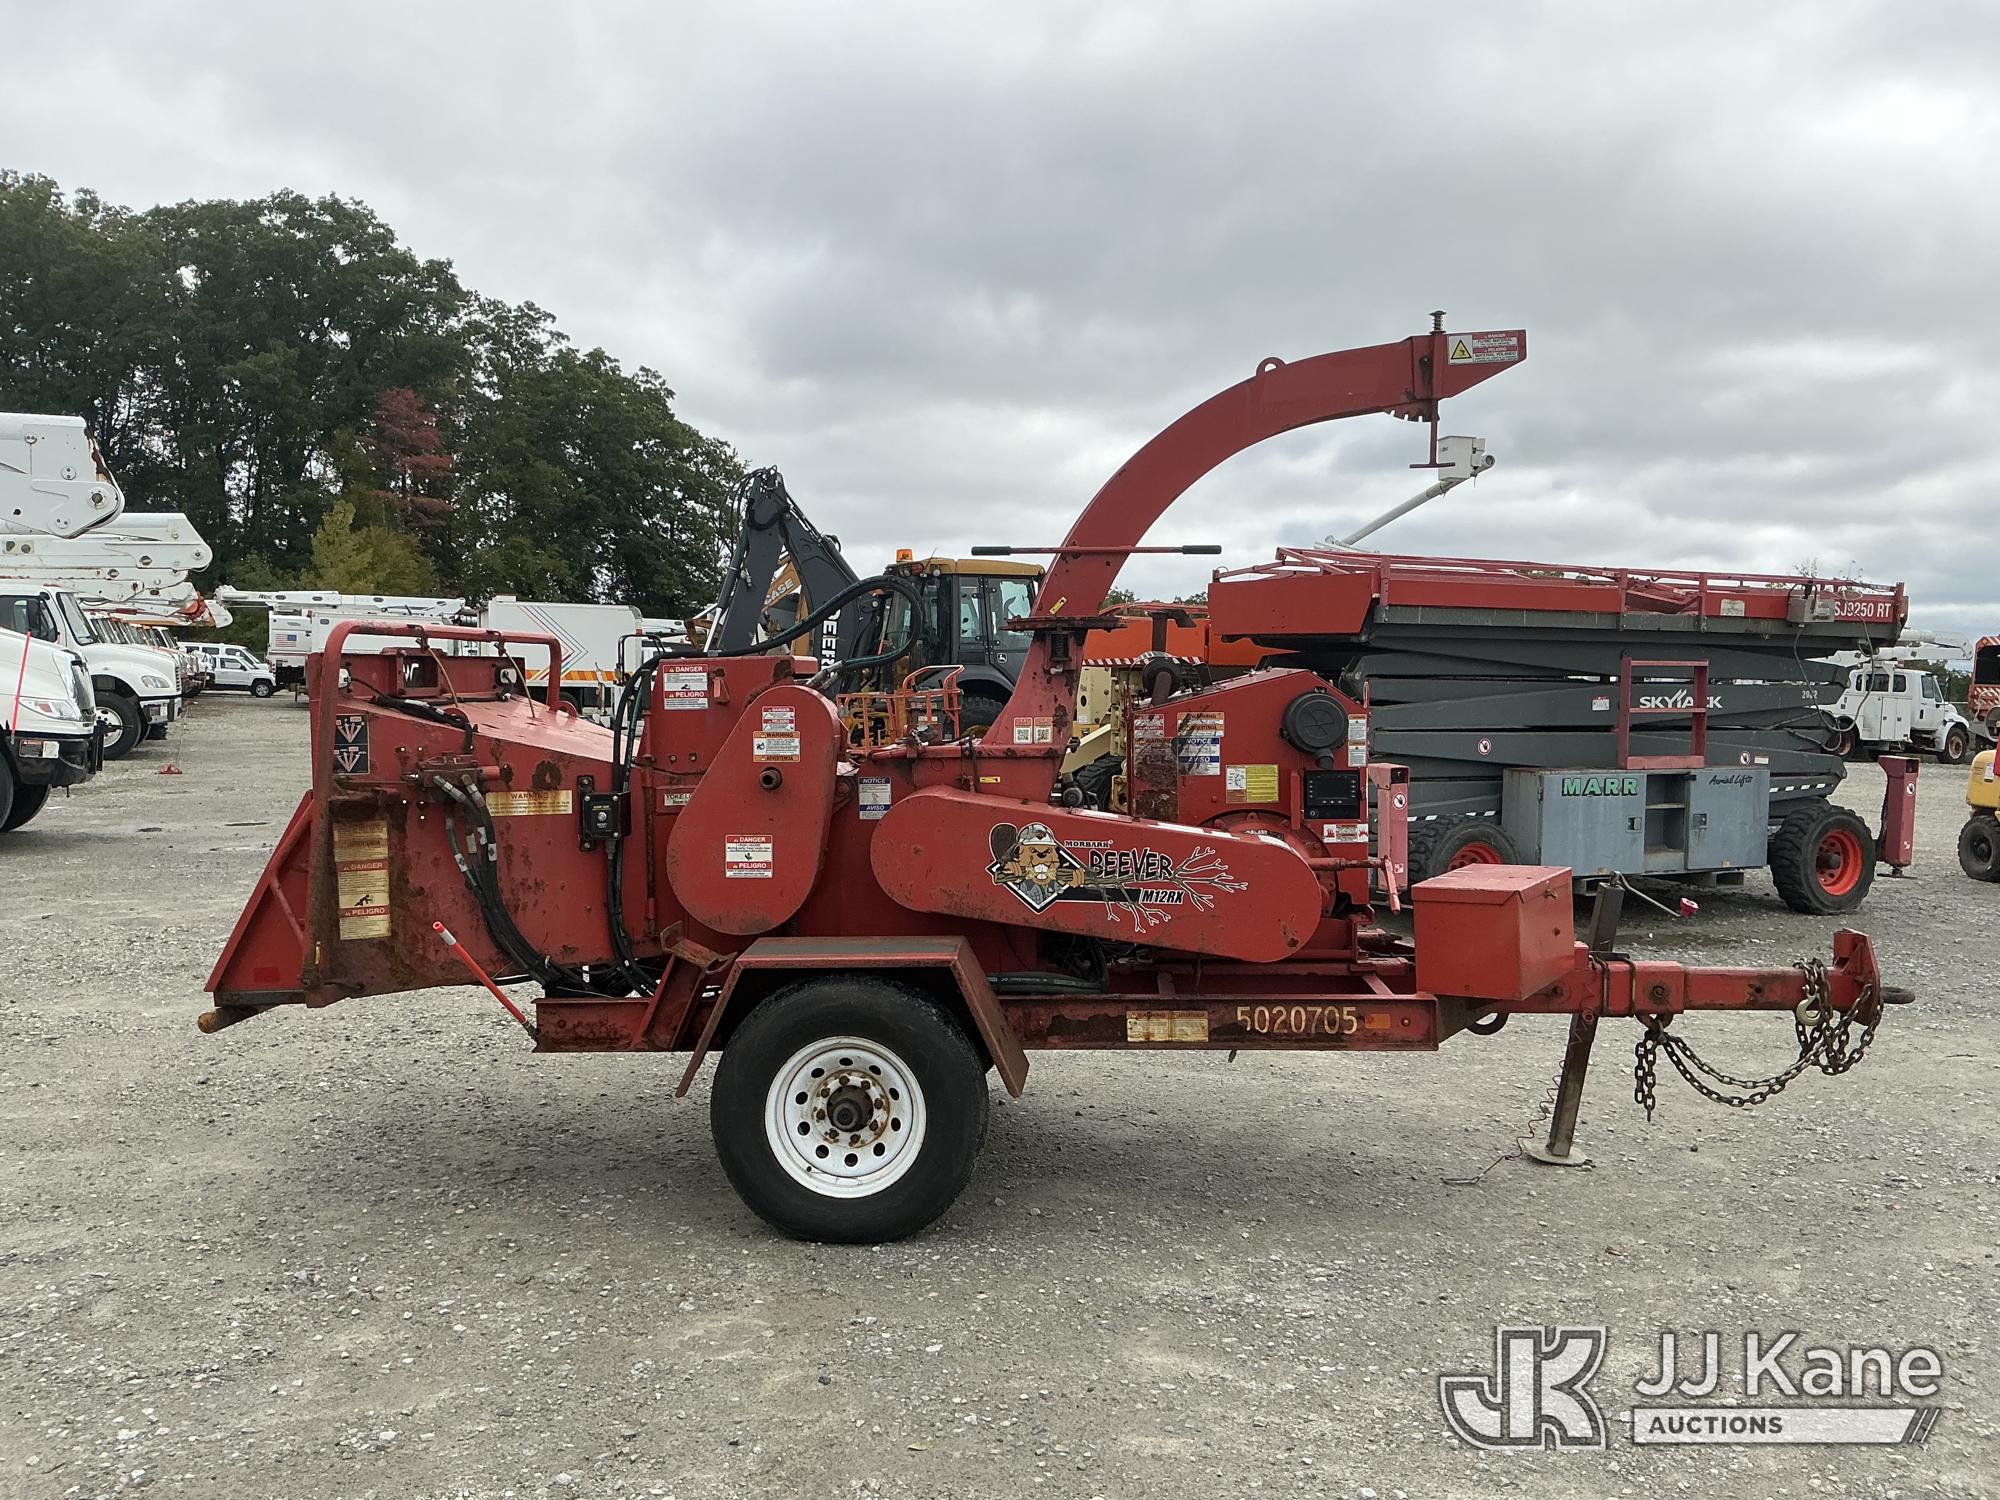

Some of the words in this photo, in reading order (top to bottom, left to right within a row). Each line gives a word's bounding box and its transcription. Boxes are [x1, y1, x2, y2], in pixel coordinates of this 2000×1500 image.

[1876, 603, 1891, 617] RT
[1639, 689, 1723, 709] SKYJAK
[1562, 778, 1637, 796] MARR
[1089, 848, 1174, 881] BEEVER
[1141, 890, 1184, 903] M12RX
[1236, 1005, 1358, 1035] 5020705
